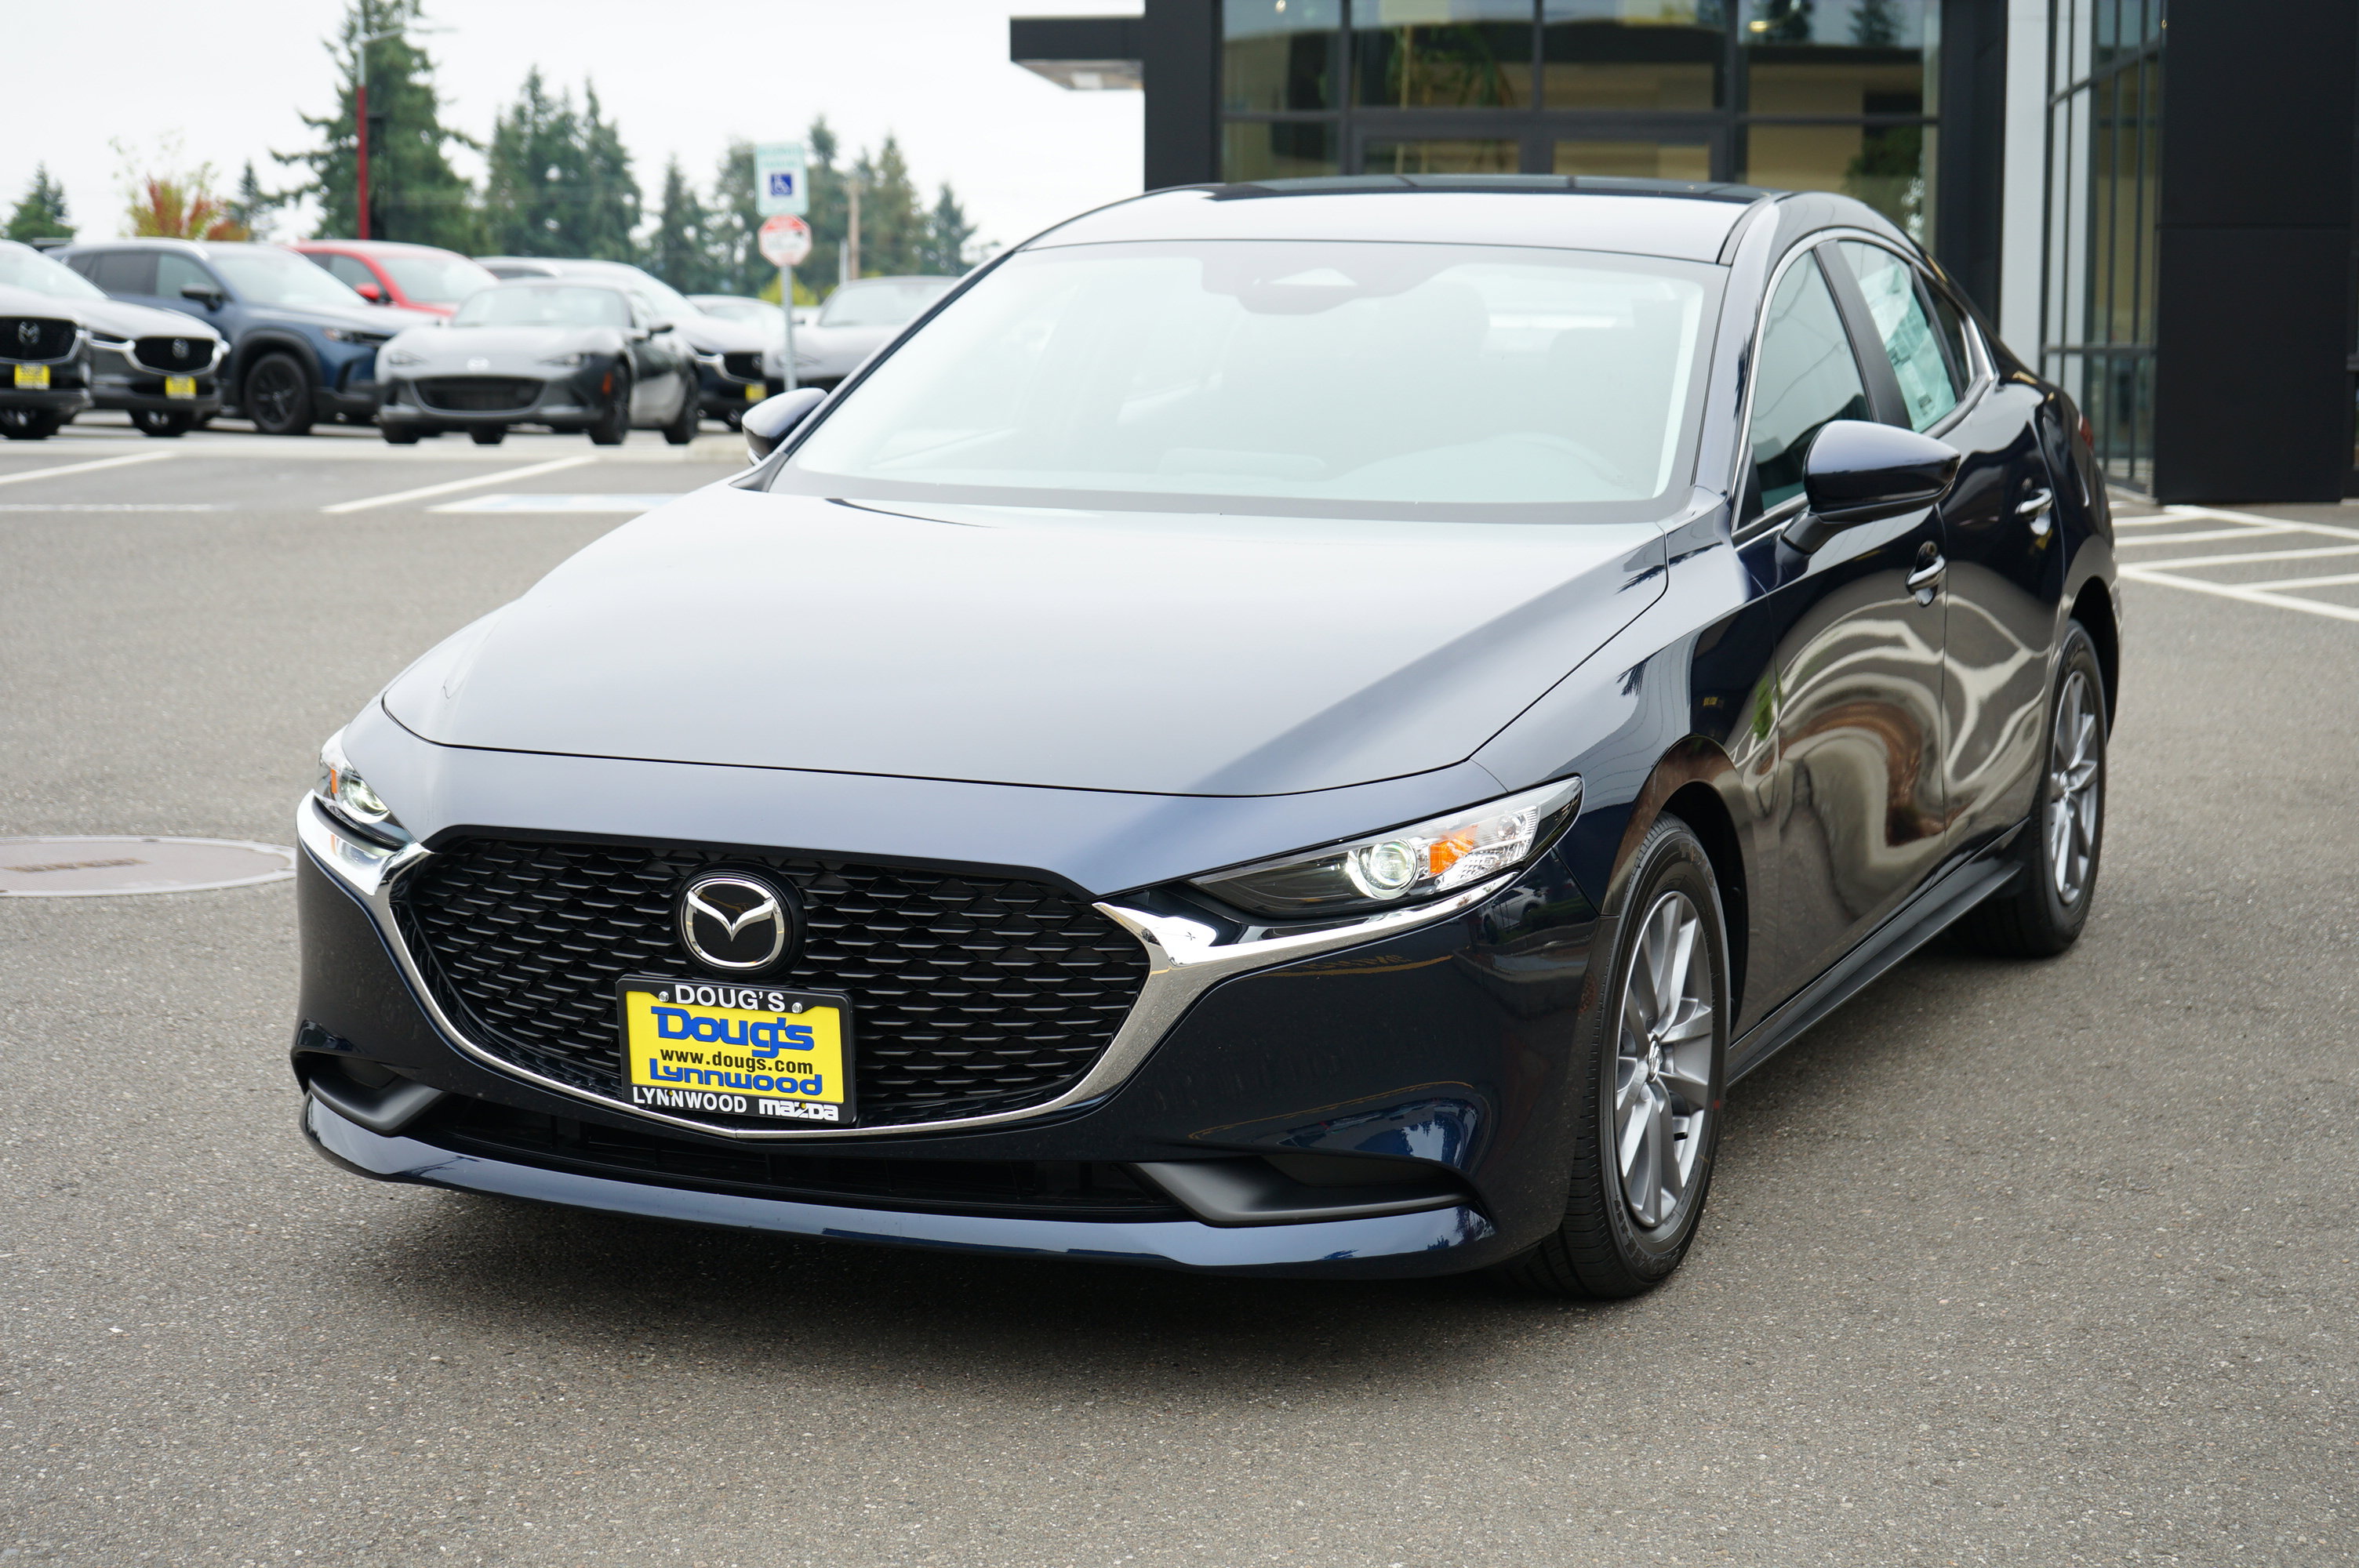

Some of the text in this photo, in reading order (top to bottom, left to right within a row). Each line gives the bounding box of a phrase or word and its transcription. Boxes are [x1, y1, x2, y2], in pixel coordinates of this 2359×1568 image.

[675, 985, 786, 1012] DOUG'S
[651, 1006, 814, 1058] Doug's
[660, 1049, 813, 1074] www.dougs.com
[649, 1058, 823, 1095] Lynnwood
[633, 1087, 747, 1113] LYNNWOOD
